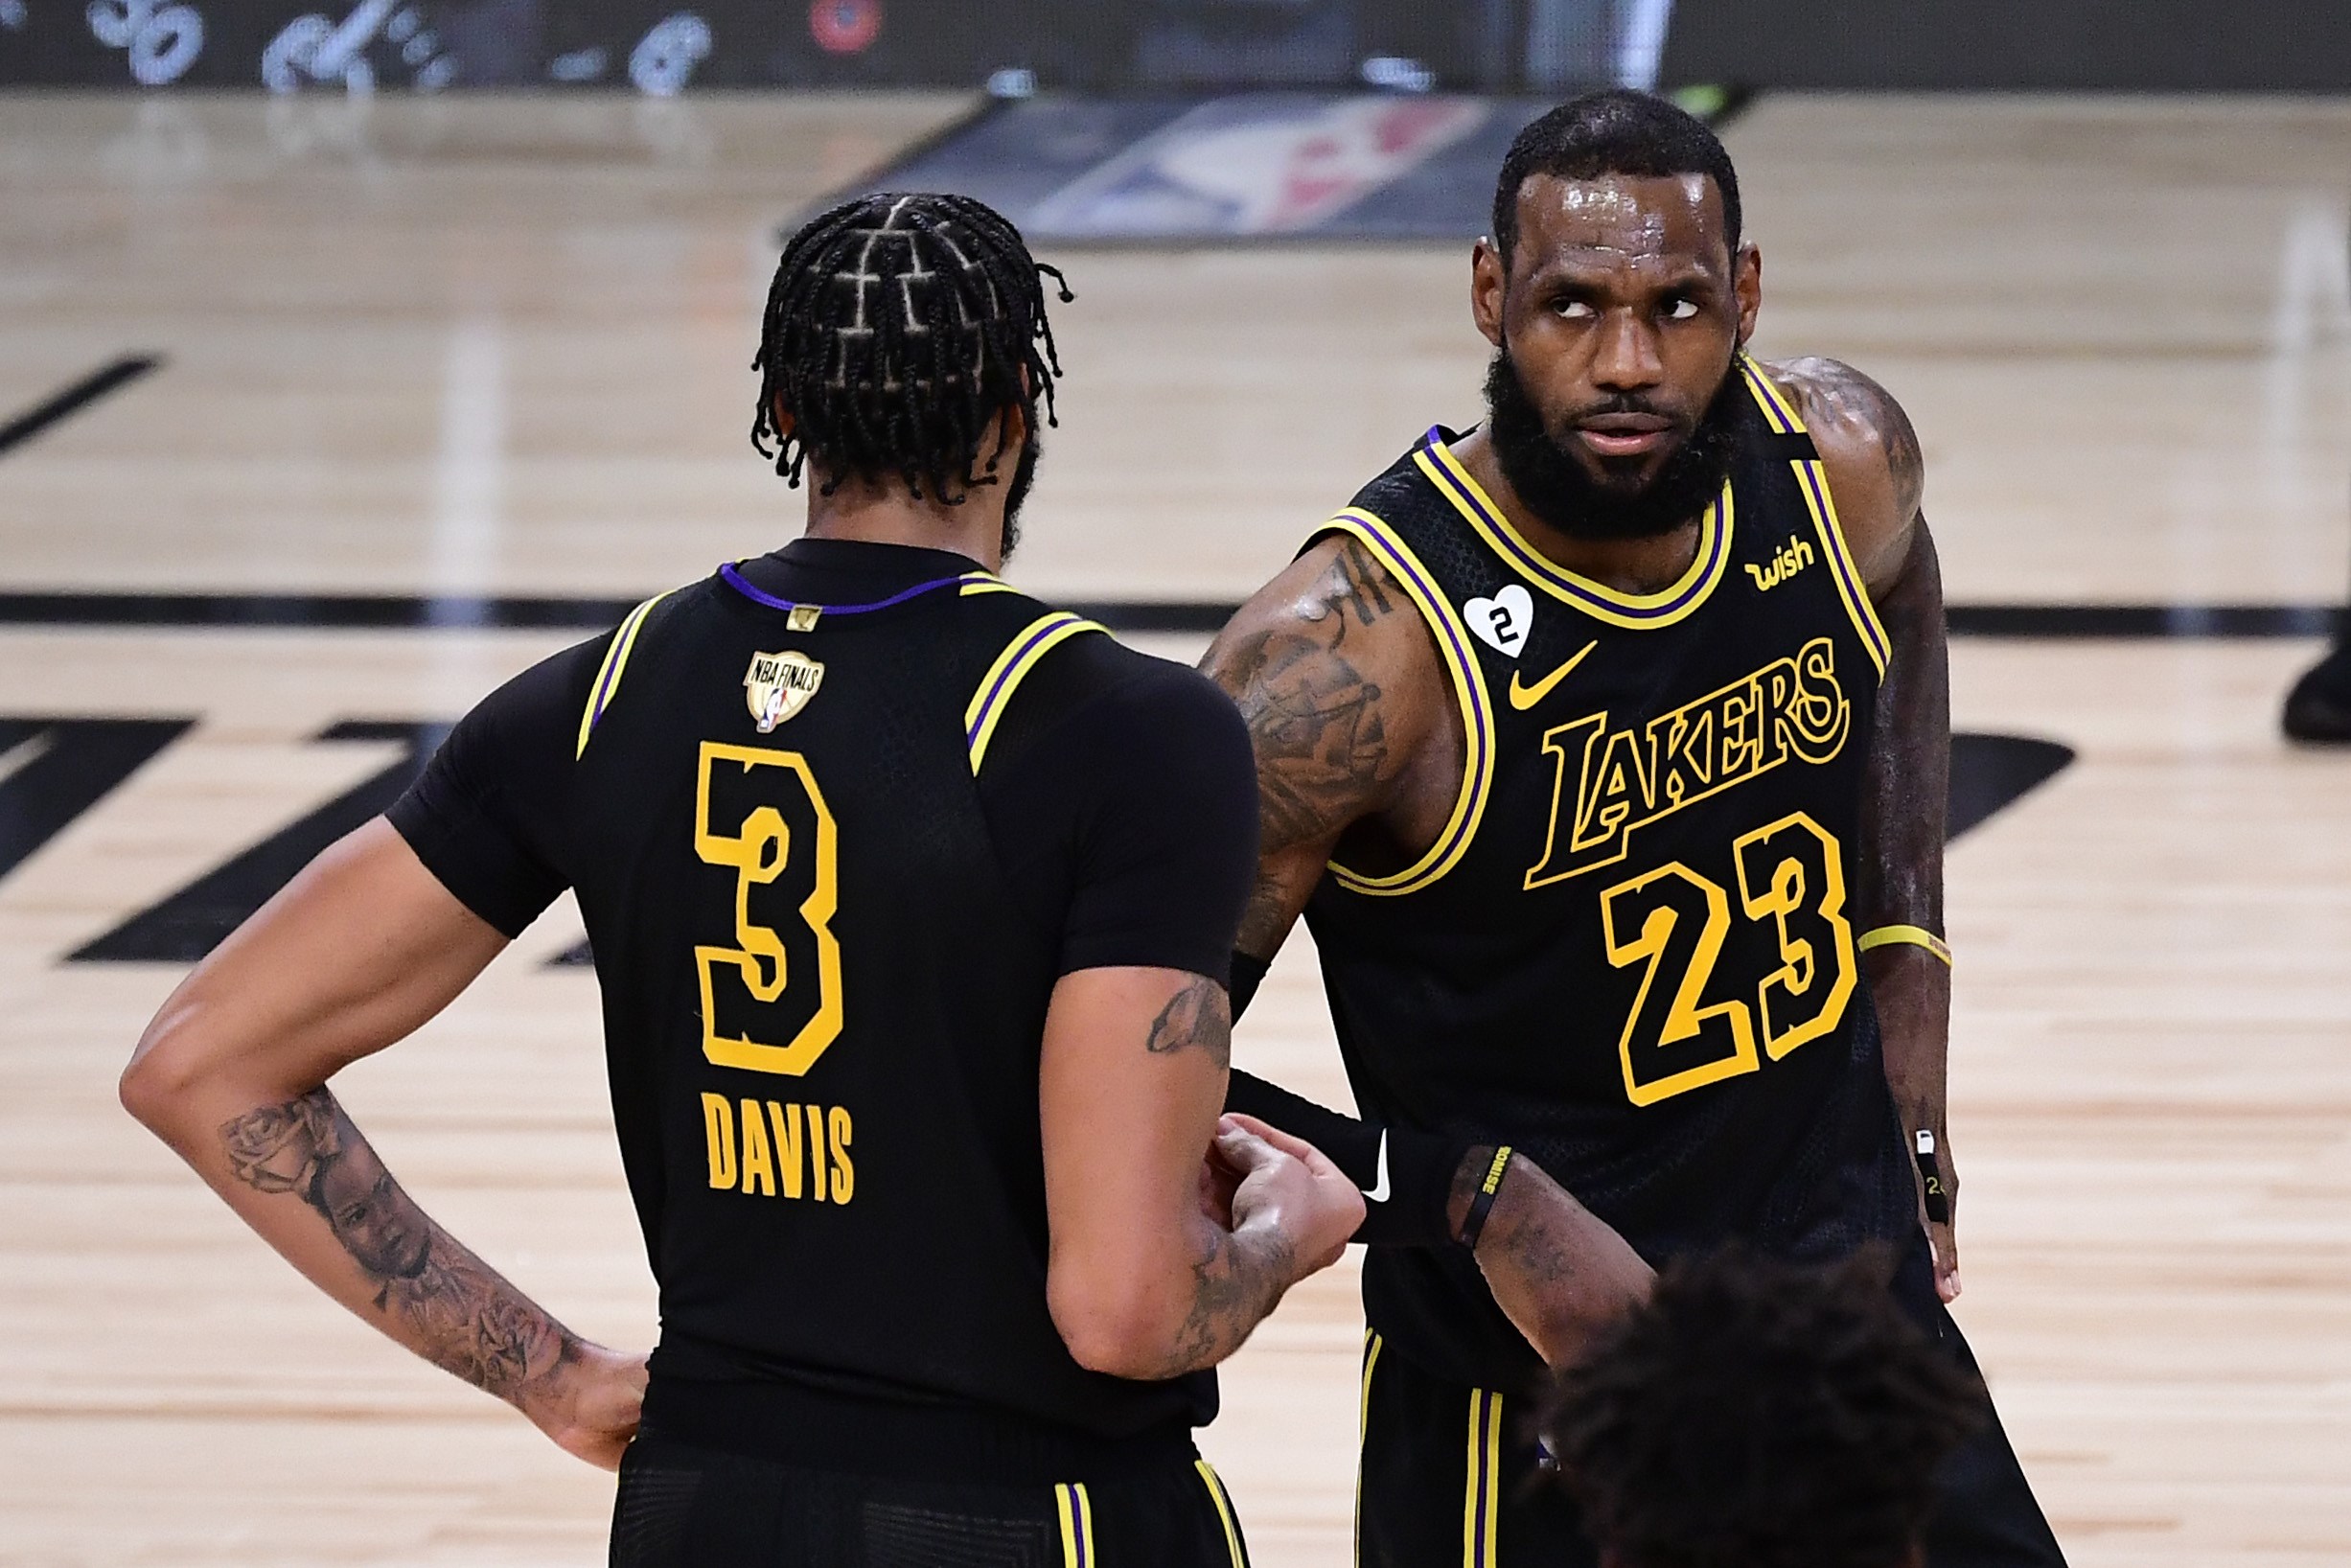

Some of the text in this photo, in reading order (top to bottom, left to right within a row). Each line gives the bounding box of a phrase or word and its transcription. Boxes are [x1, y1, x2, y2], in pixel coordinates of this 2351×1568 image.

[1744, 535, 1814, 591] wish
[750, 658, 819, 692] NBA FINALS
[1488, 606, 1519, 645] 2
[1523, 637, 1850, 890] LAKERS
[695, 741, 843, 1076] 3
[1600, 811, 1857, 1106] 23
[701, 1093, 854, 1205] DAVIS
